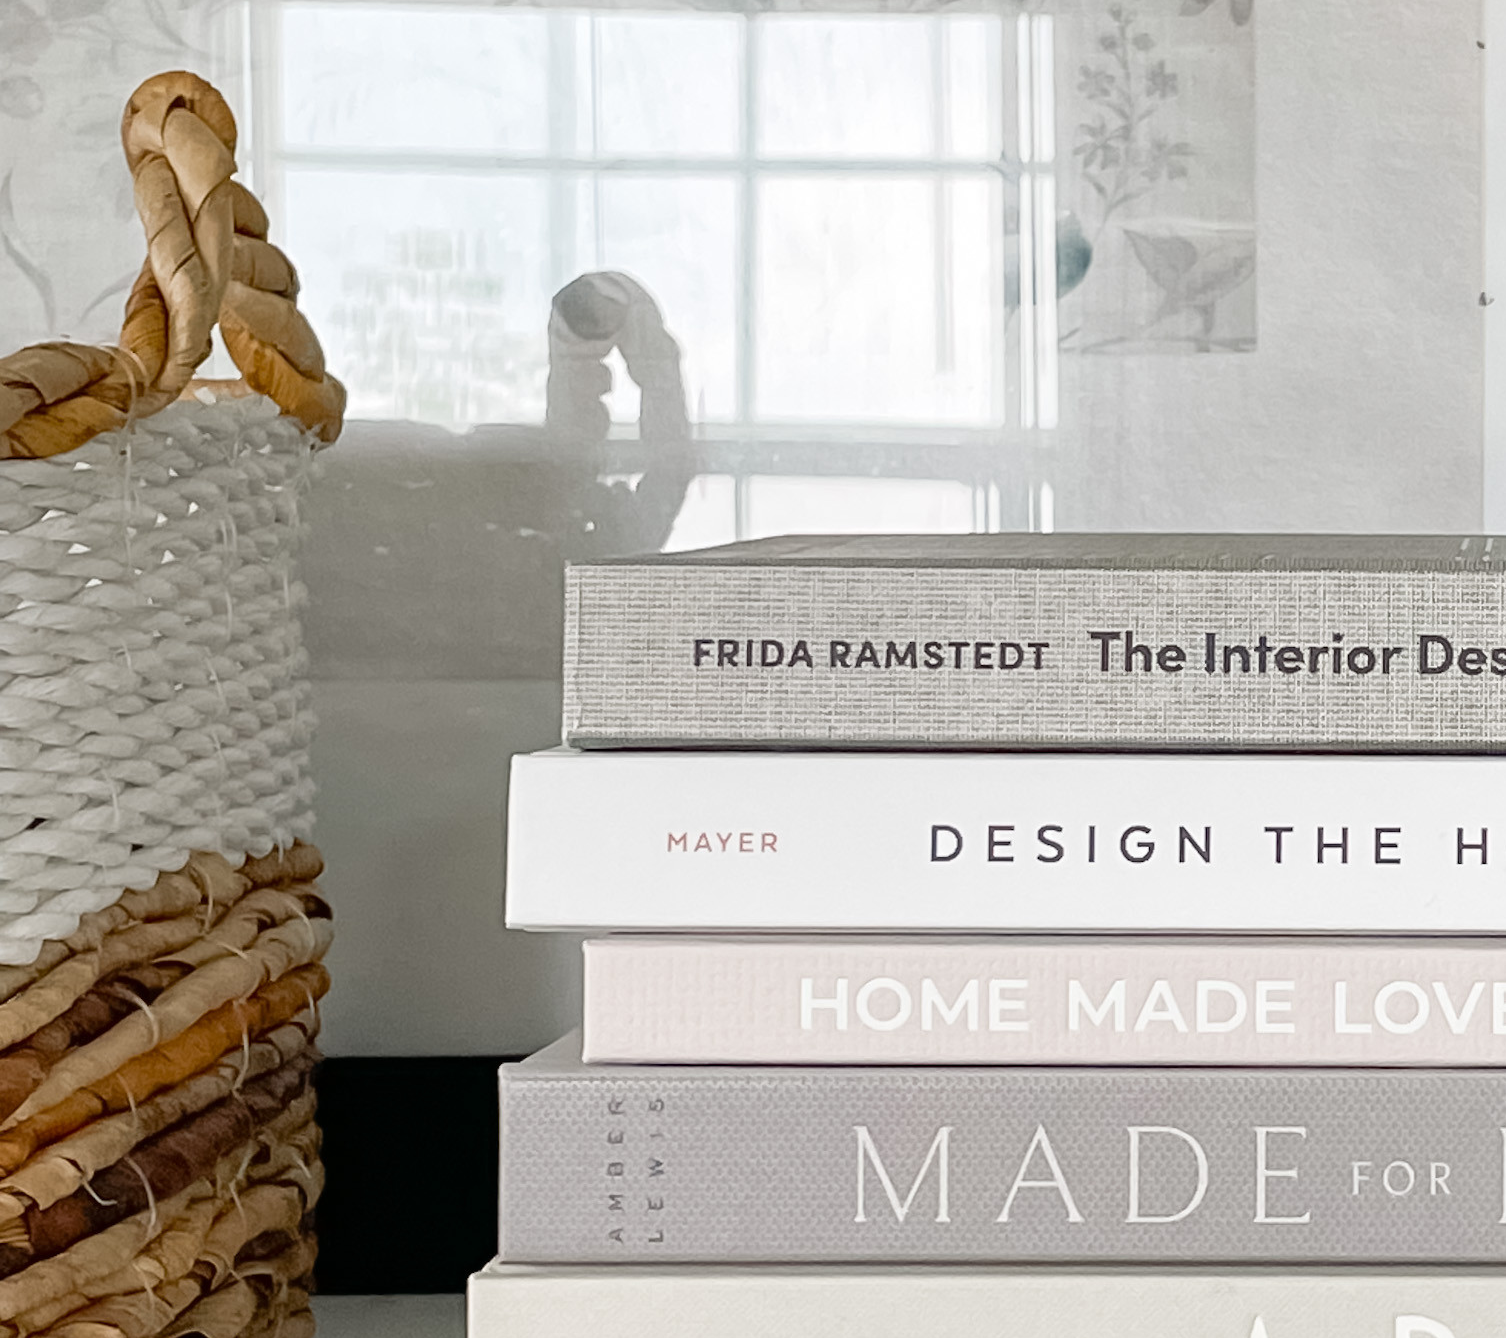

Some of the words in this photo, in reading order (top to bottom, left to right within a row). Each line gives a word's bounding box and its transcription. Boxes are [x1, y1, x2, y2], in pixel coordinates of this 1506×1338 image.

[693, 638, 814, 669] FRIDA
[828, 640, 1051, 672] RAMSTEDT
[1088, 630, 1187, 674] The
[1204, 631, 1402, 677] Interior
[666, 831, 779, 854] MAYER
[929, 824, 1214, 865] DESIGN
[1264, 826, 1404, 865] THE
[799, 976, 1029, 1033] HOME
[1066, 978, 1296, 1035] MADE
[606, 1095, 625, 1244] AMBER
[647, 1097, 665, 1244] LEWIS
[851, 1124, 1312, 1227] MADE
[1350, 1159, 1453, 1196] FOR
